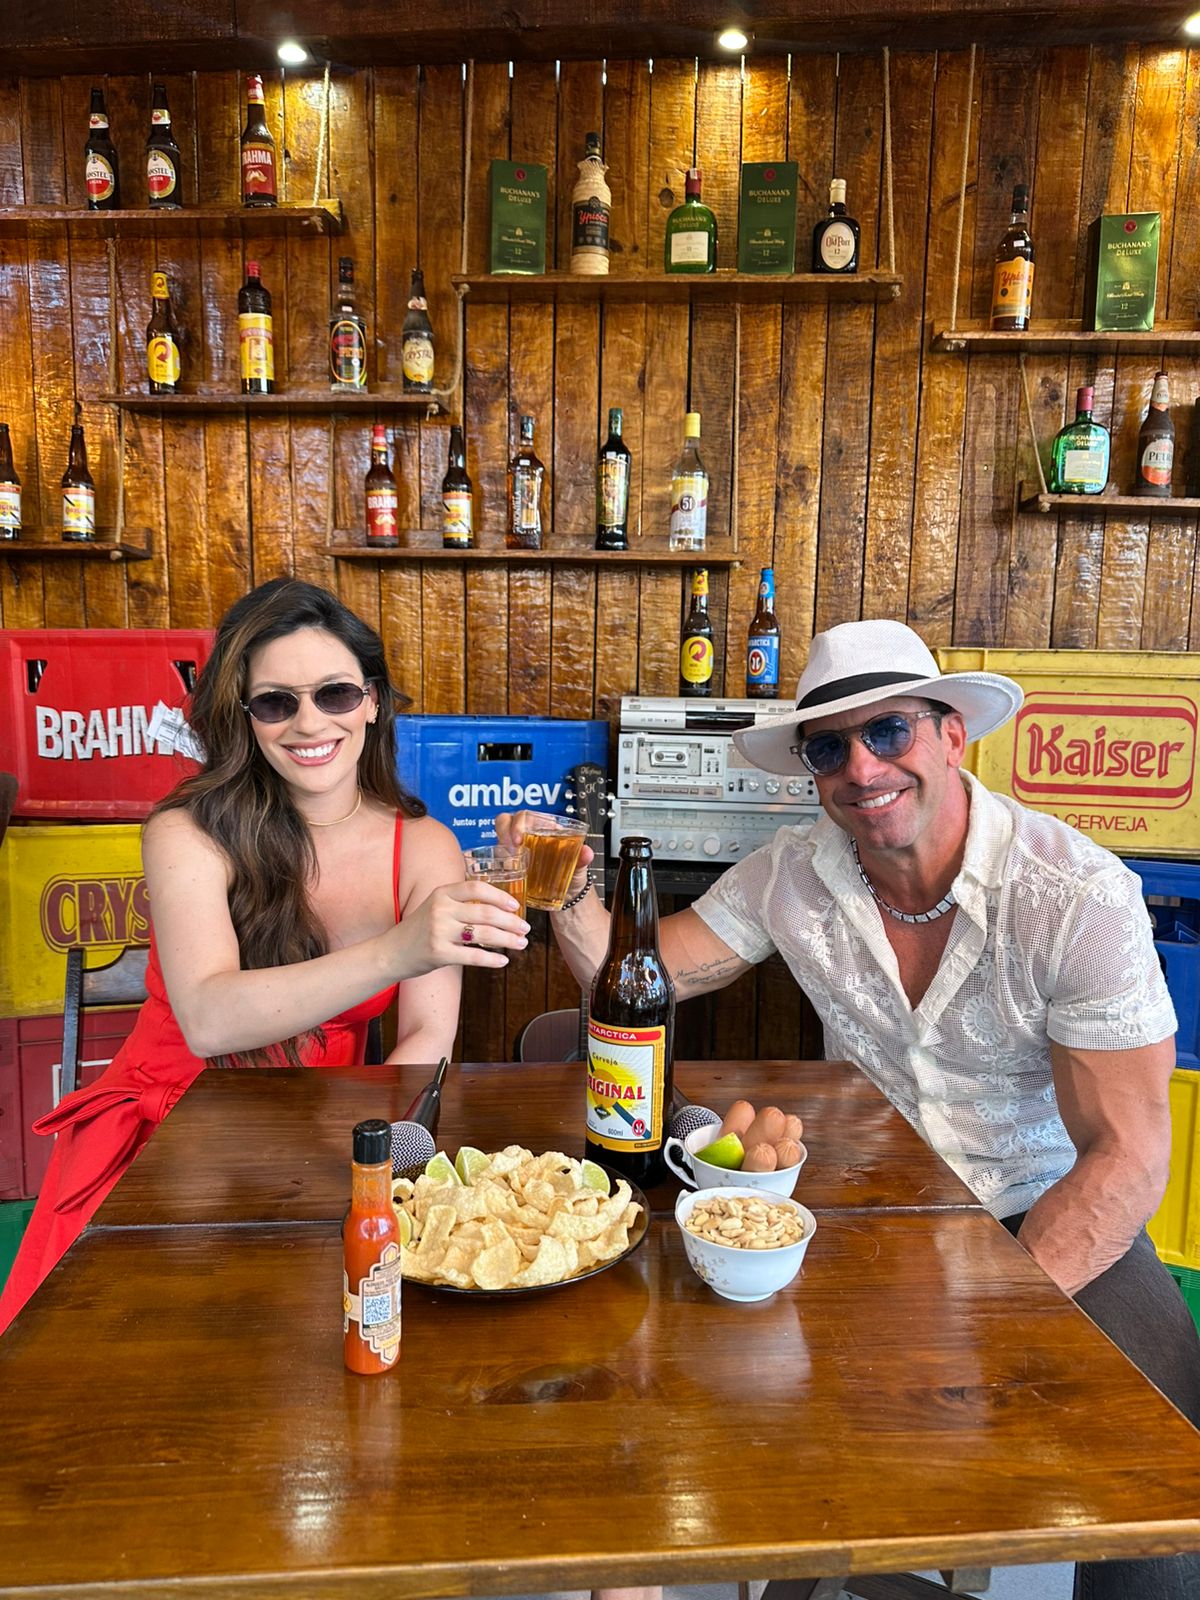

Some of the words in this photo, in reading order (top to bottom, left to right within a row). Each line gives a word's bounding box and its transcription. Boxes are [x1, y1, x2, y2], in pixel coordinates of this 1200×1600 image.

[242, 150, 272, 165] RAHMA
[500, 187, 540, 198] BUCHANAN'S
[748, 189, 790, 197] BUCHANAN'S
[826, 237, 838, 248] Old
[1107, 241, 1151, 250] BUCHANAN'S
[1149, 451, 1172, 461] PETR
[682, 497, 692, 511] 51
[1027, 722, 1185, 779] Kaiser
[448, 776, 562, 808] ambev
[452, 817, 477, 827] Juntos
[478, 818, 491, 828] por
[1064, 814, 1148, 831] CERVEJA
[480, 829, 498, 839] amb
[45, 877, 151, 946] CRYS
[592, 1025, 637, 1041] TARCTICA
[592, 1052, 619, 1066] Cerveja
[587, 1074, 646, 1100] RIGINAL
[607, 1128, 623, 1136] 600ml
